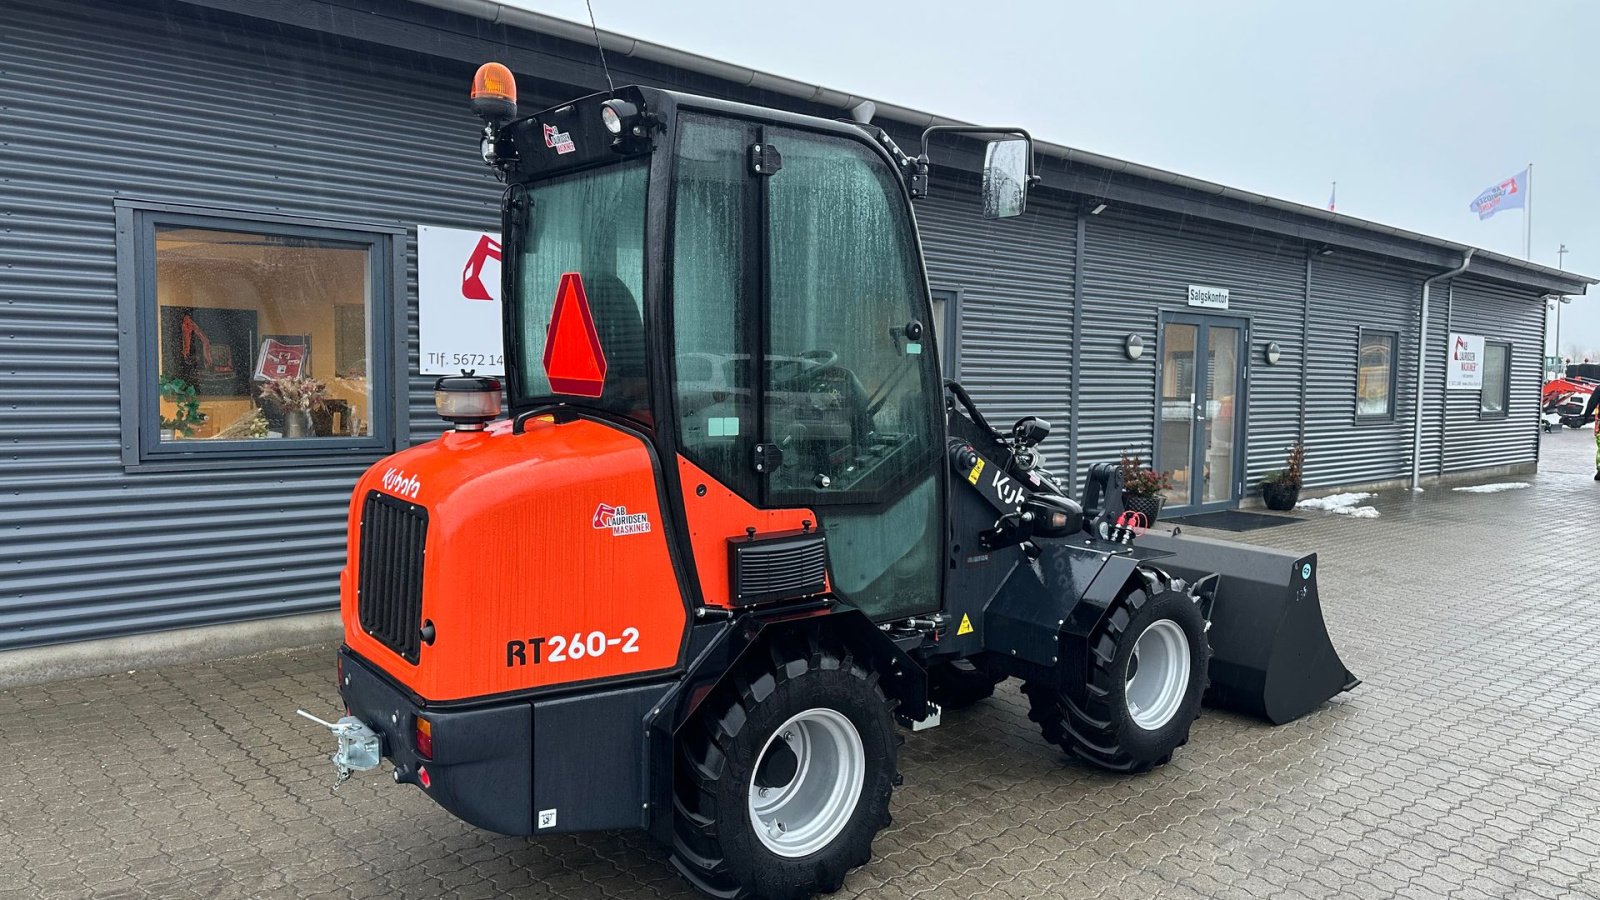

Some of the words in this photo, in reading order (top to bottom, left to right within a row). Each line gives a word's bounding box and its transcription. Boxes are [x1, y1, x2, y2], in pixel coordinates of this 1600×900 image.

[1190, 289, 1228, 303] Salgskontor
[427, 352, 449, 368] Tlf.
[453, 353, 485, 366] 5672
[382, 467, 421, 499] Kubota
[616, 507, 626, 516] AB
[607, 514, 647, 526] LAURIDSEN
[613, 522, 650, 534] MASKINER
